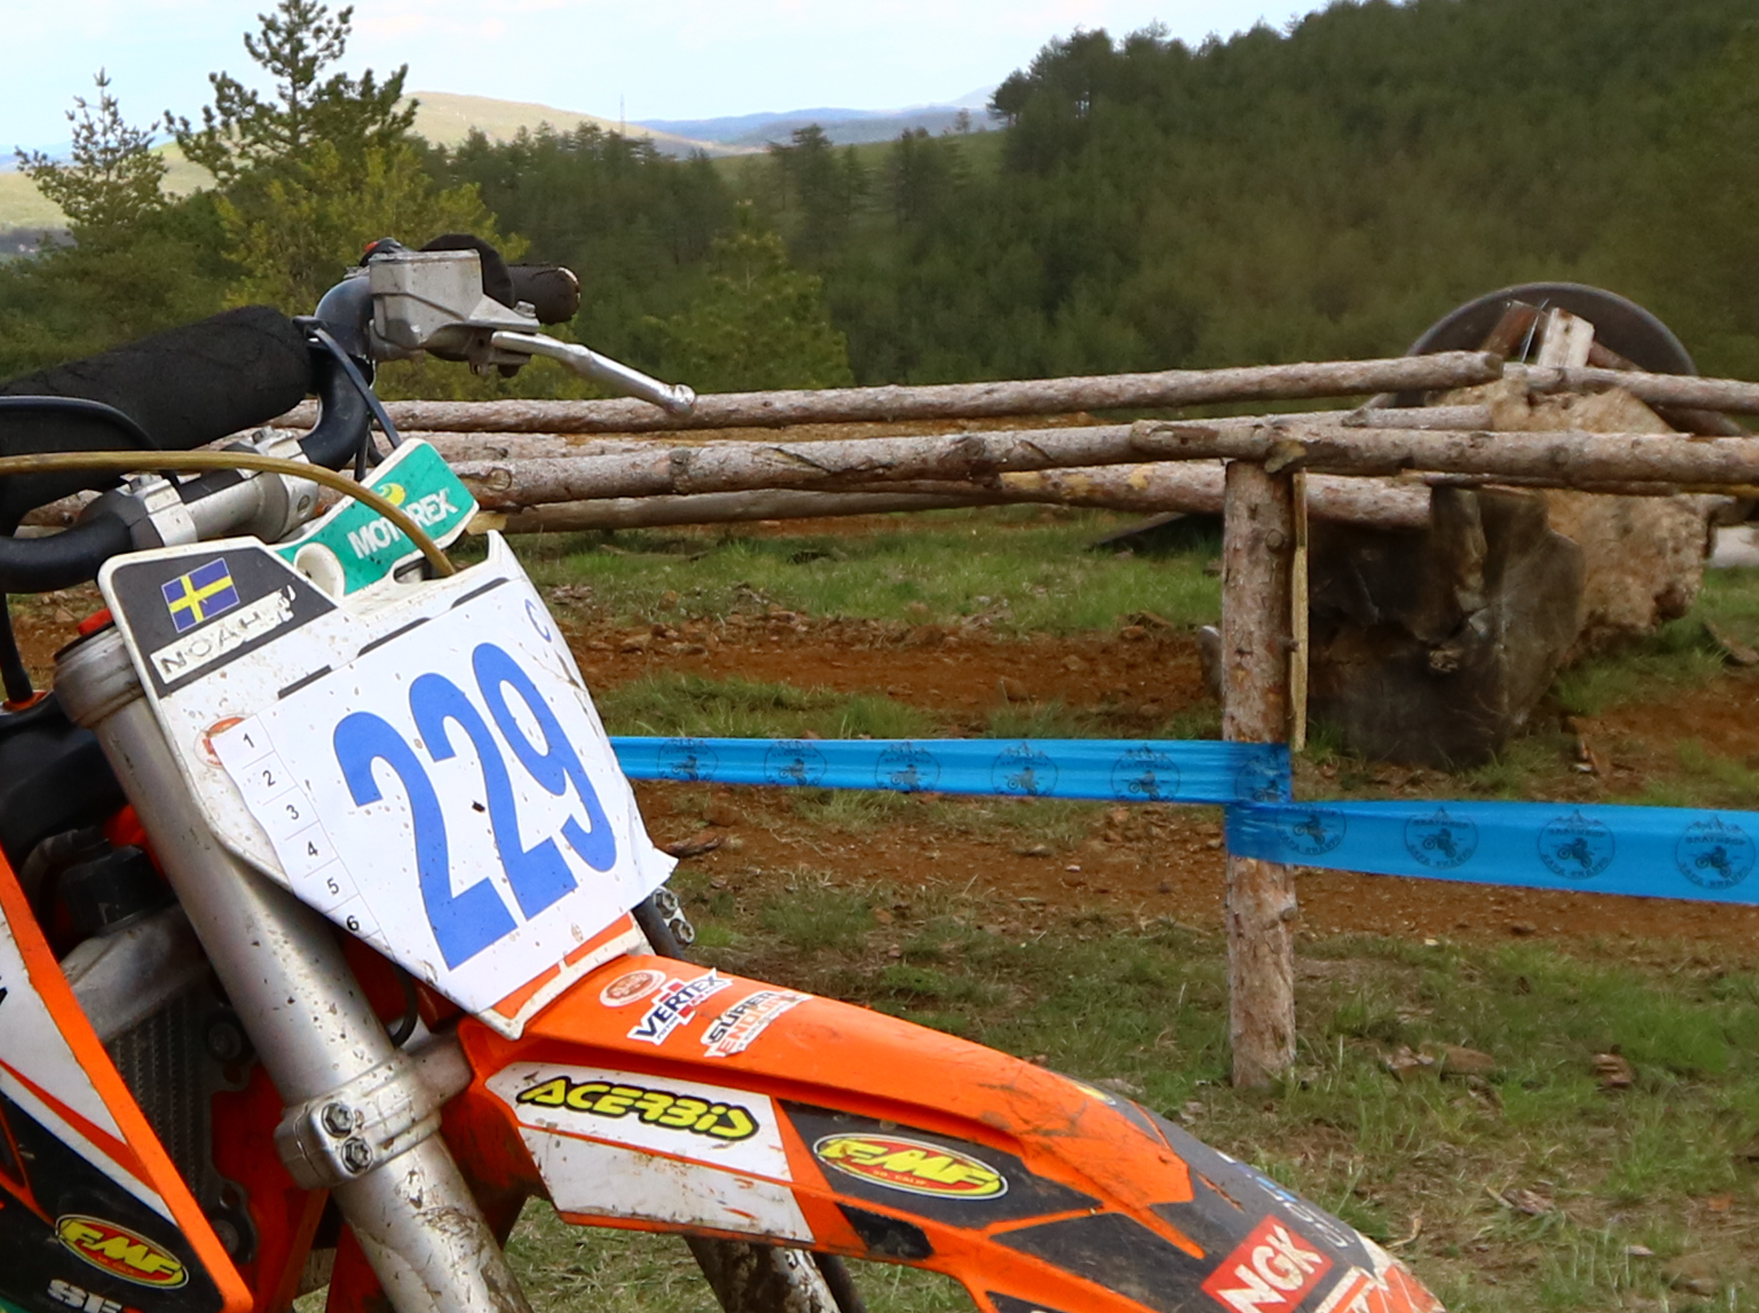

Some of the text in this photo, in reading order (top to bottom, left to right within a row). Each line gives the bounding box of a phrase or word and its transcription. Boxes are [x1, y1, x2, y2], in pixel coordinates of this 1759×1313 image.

[347, 487, 459, 559] MOTREX
[160, 611, 261, 674] NOAH
[243, 733, 255, 748] 1
[262, 770, 276, 787] 2
[334, 643, 617, 970] 229
[286, 805, 300, 820] 3
[307, 841, 319, 857] 4
[327, 878, 340, 895] 5
[346, 915, 360, 932] 6
[634, 975, 729, 1038] VERTEX
[520, 1077, 758, 1140] ACERBIS
[817, 1137, 1002, 1196] FMF
[59, 1219, 183, 1276] FMF
